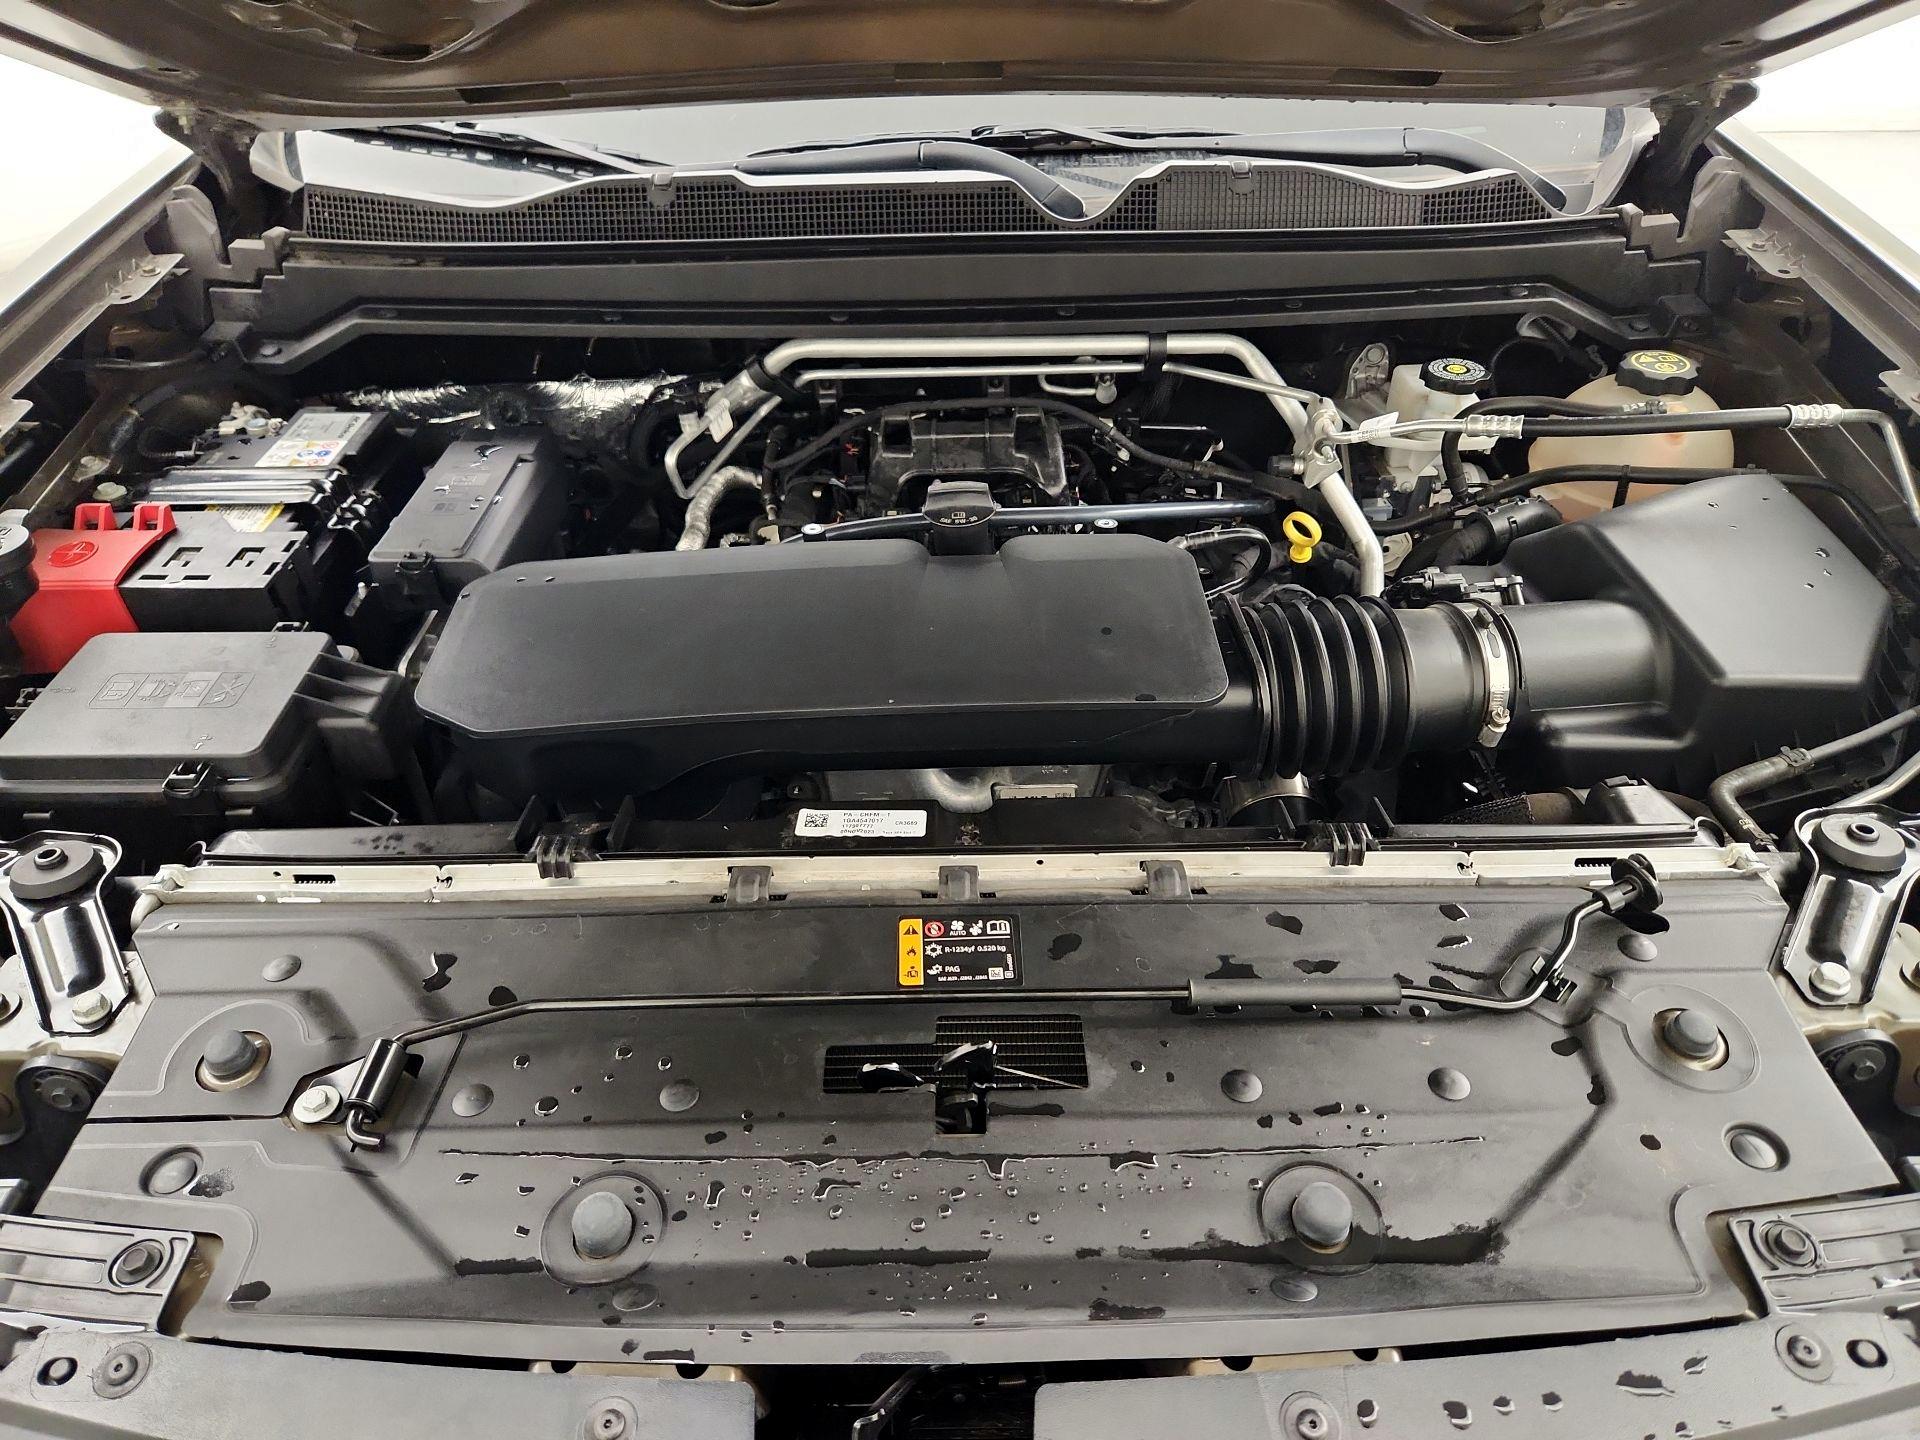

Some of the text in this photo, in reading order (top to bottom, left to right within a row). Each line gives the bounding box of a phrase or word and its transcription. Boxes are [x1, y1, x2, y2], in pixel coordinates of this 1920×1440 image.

[944, 944, 1007, 954] R-1234yf 0.520 kg
[944, 965, 960, 973] PAG
